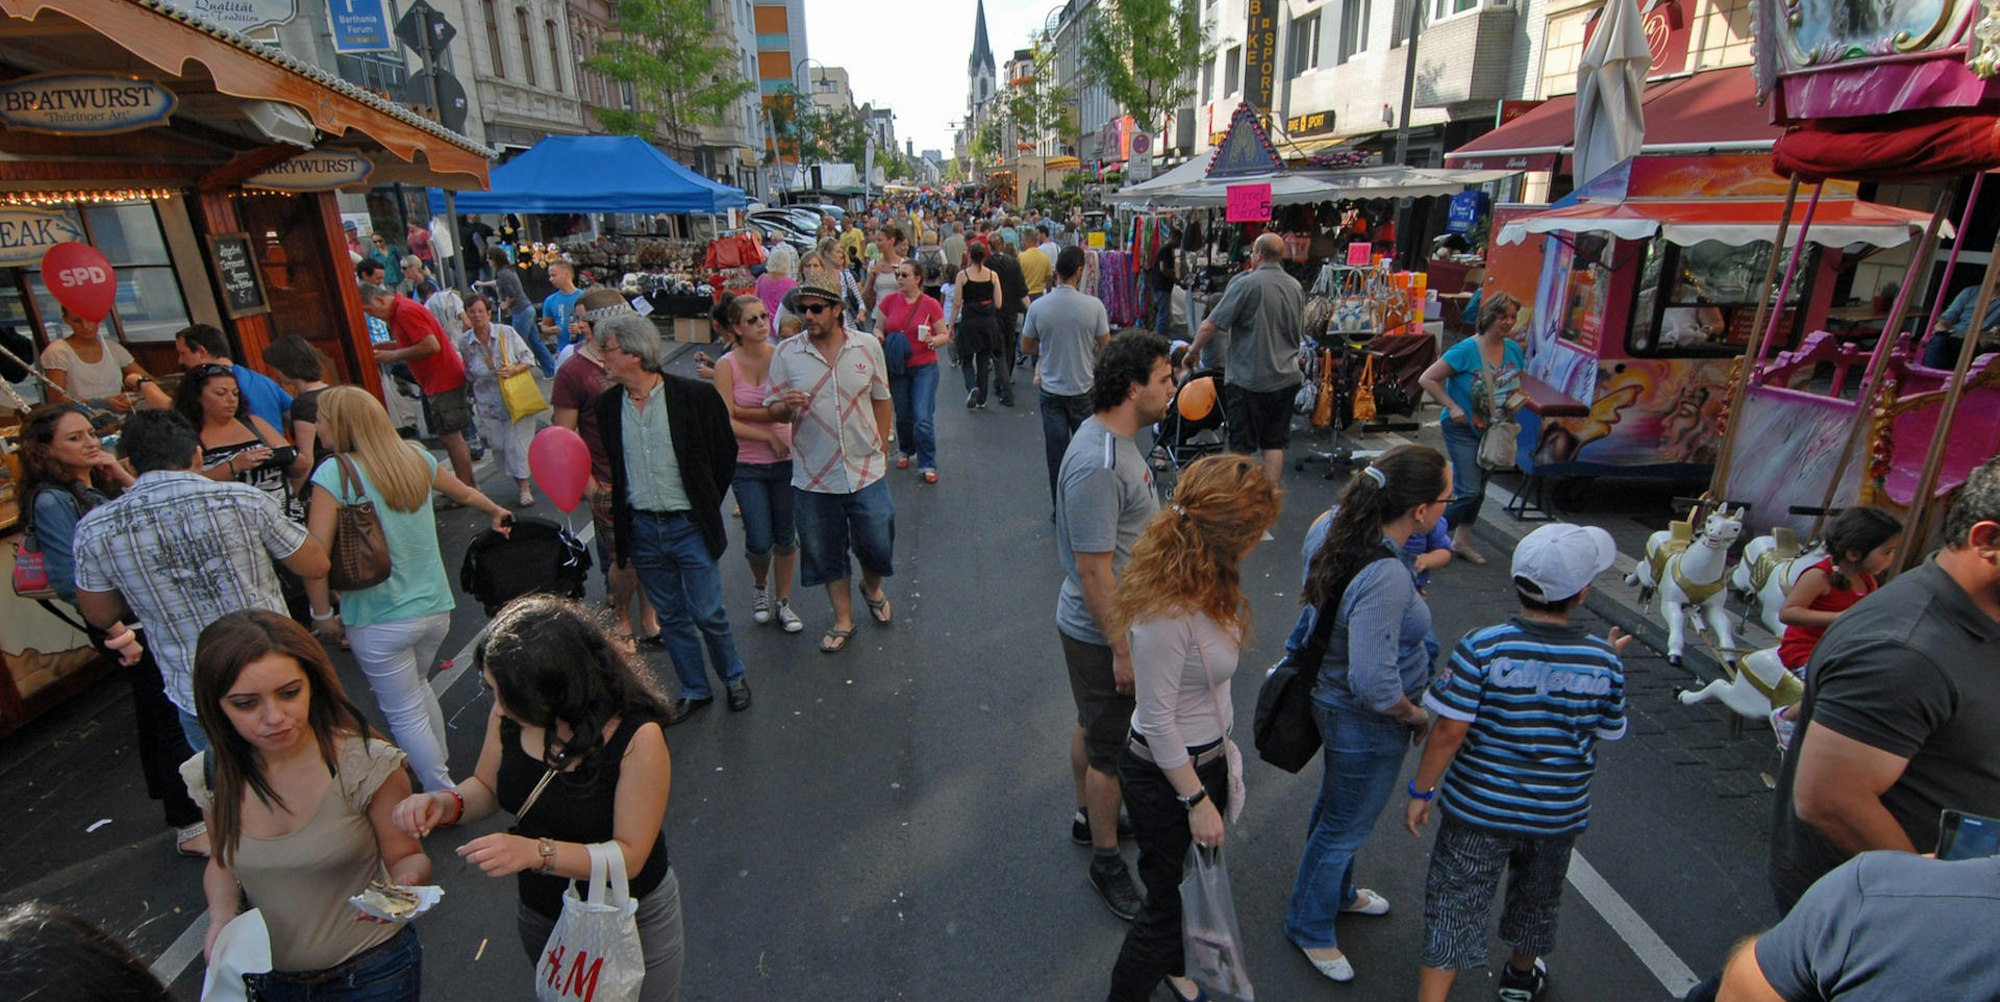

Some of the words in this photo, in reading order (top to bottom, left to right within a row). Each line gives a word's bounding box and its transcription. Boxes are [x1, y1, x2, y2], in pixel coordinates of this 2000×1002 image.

[195, 0, 254, 12] Qualität
[348, 25, 374, 33] Forum
[1247, 0, 1261, 66] BIKE
[1261, 32, 1275, 103] SPORT
[5, 87, 154, 111] BRATWURST
[58, 266, 107, 288] SPD
